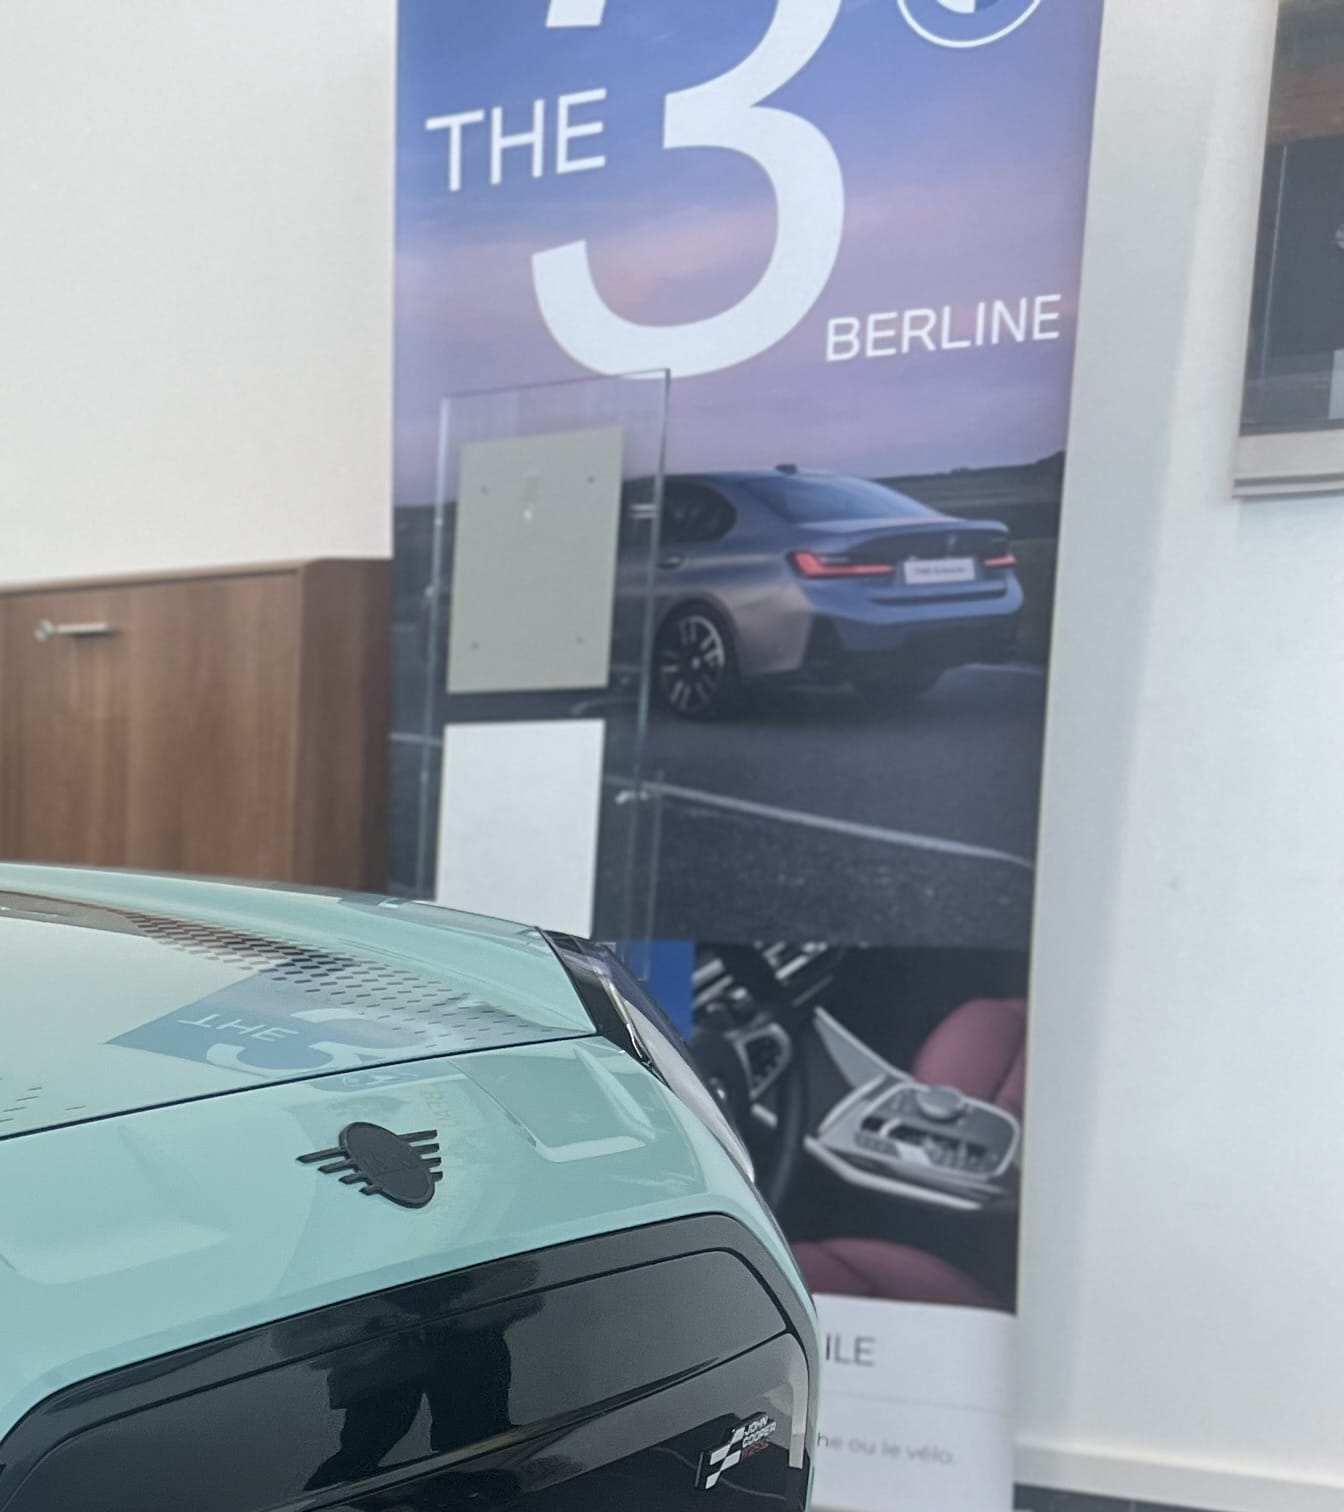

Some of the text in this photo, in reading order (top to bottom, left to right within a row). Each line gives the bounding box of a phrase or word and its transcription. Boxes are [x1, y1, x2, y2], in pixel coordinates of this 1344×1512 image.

[424, 0, 846, 379] THE 3
[824, 293, 1063, 362] BERLINE
[824, 1332, 876, 1367] ILE
